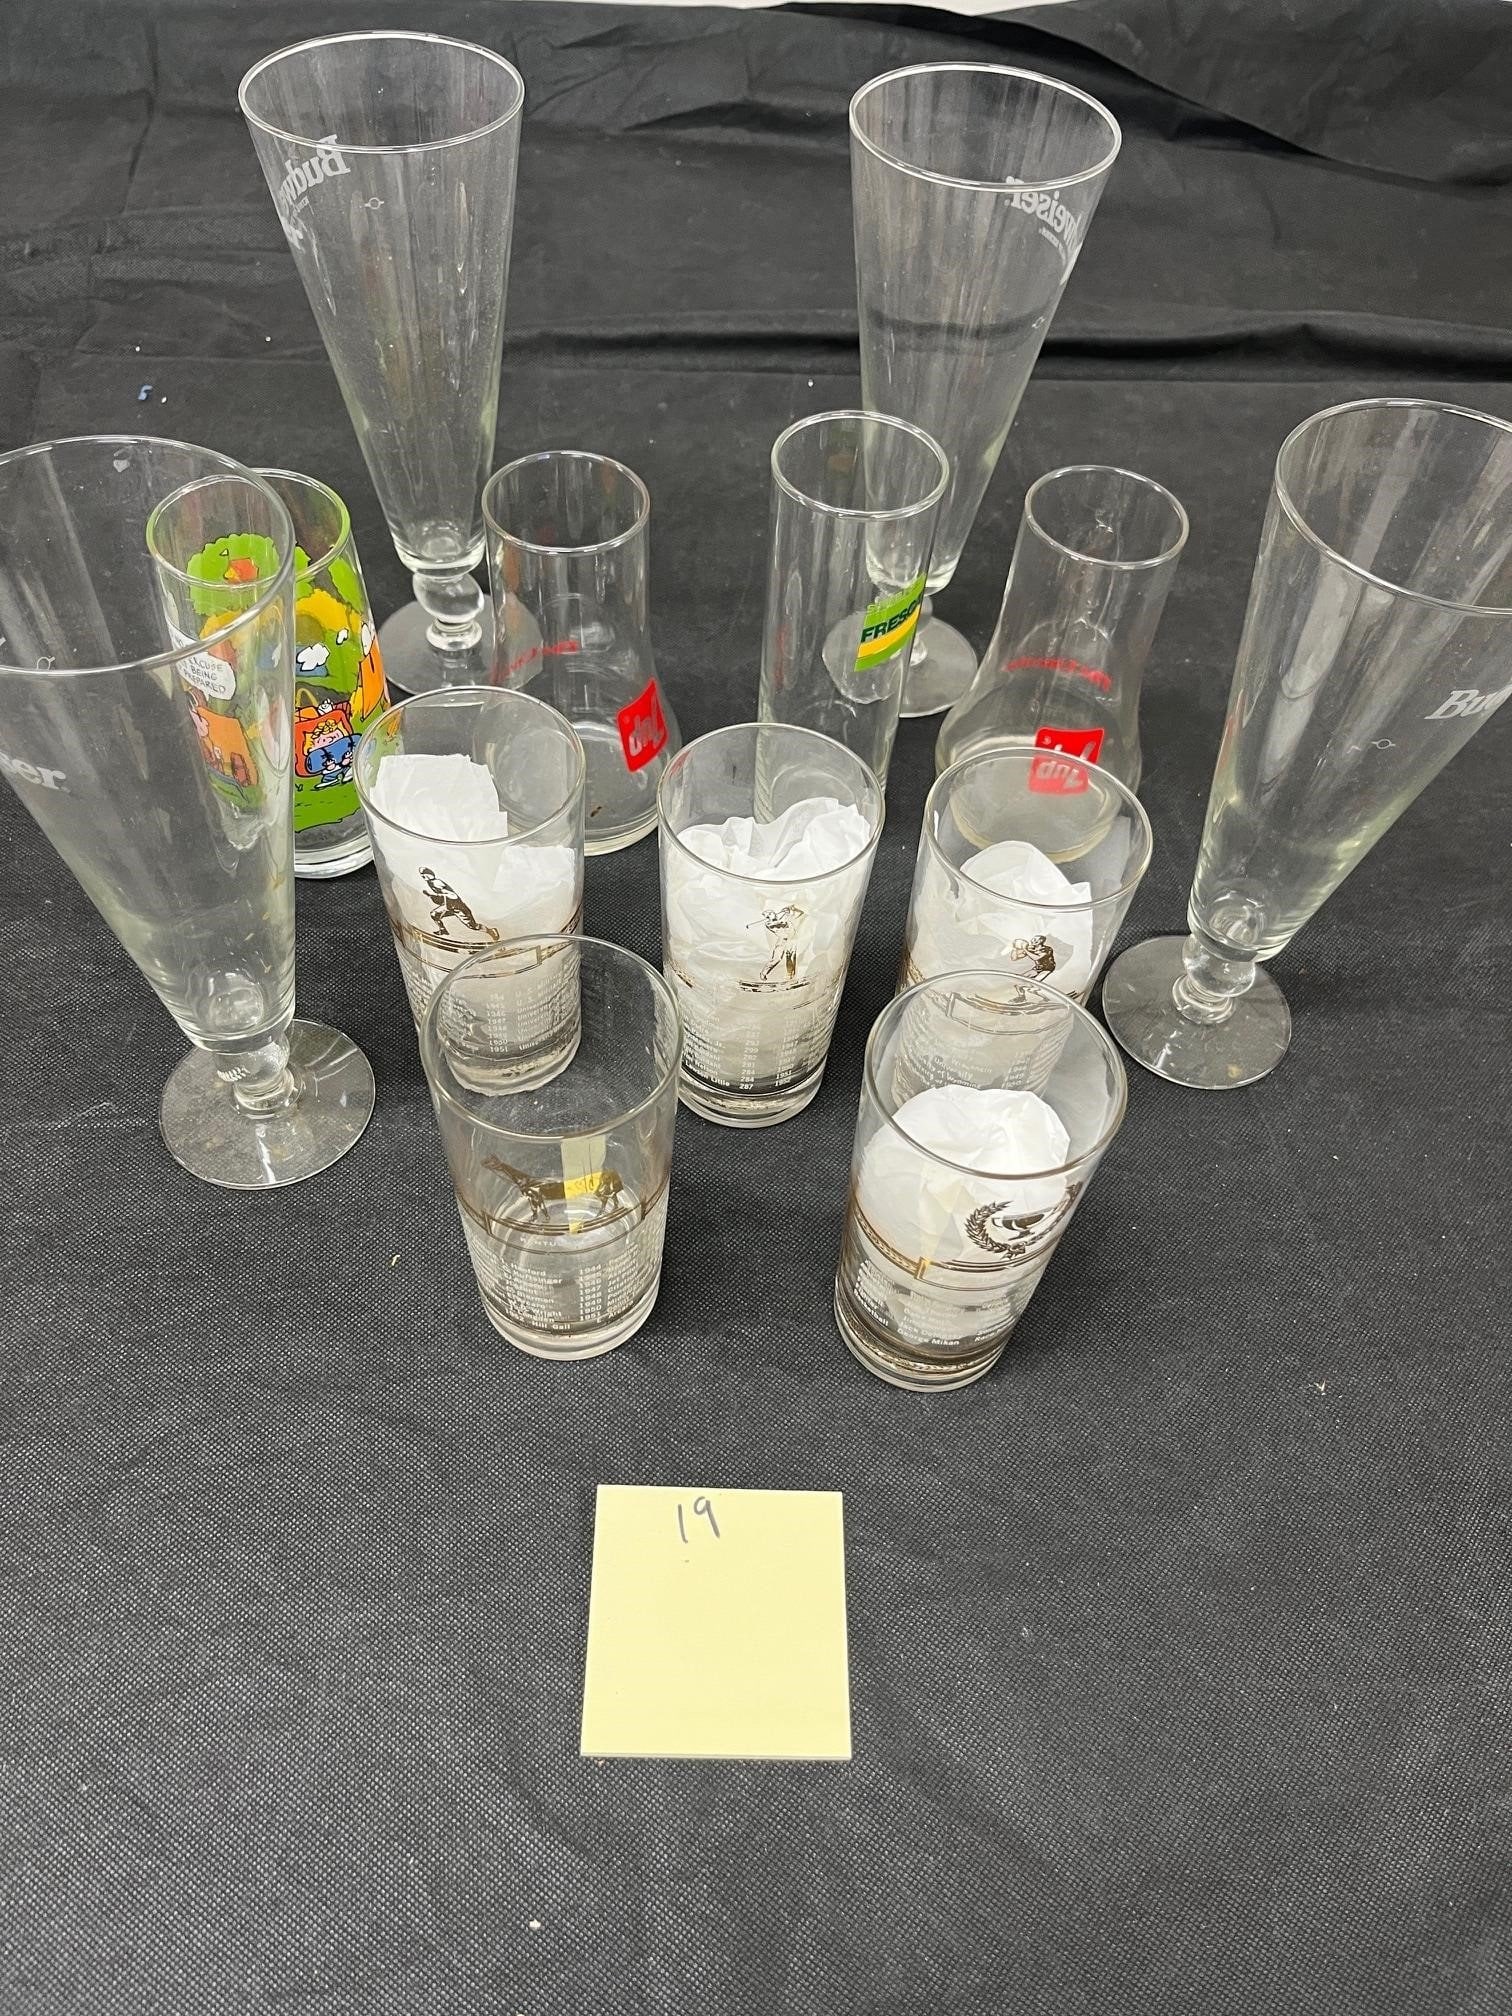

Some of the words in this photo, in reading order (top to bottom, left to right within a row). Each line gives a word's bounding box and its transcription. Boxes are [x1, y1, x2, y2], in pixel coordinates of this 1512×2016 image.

[861, 591, 924, 643] FRESC
[580, 1264, 601, 1275] 1944
[532, 1321, 547, 1329] Hill
[931, 1338, 960, 1346] Mikan
[677, 1495, 721, 1545] 19
